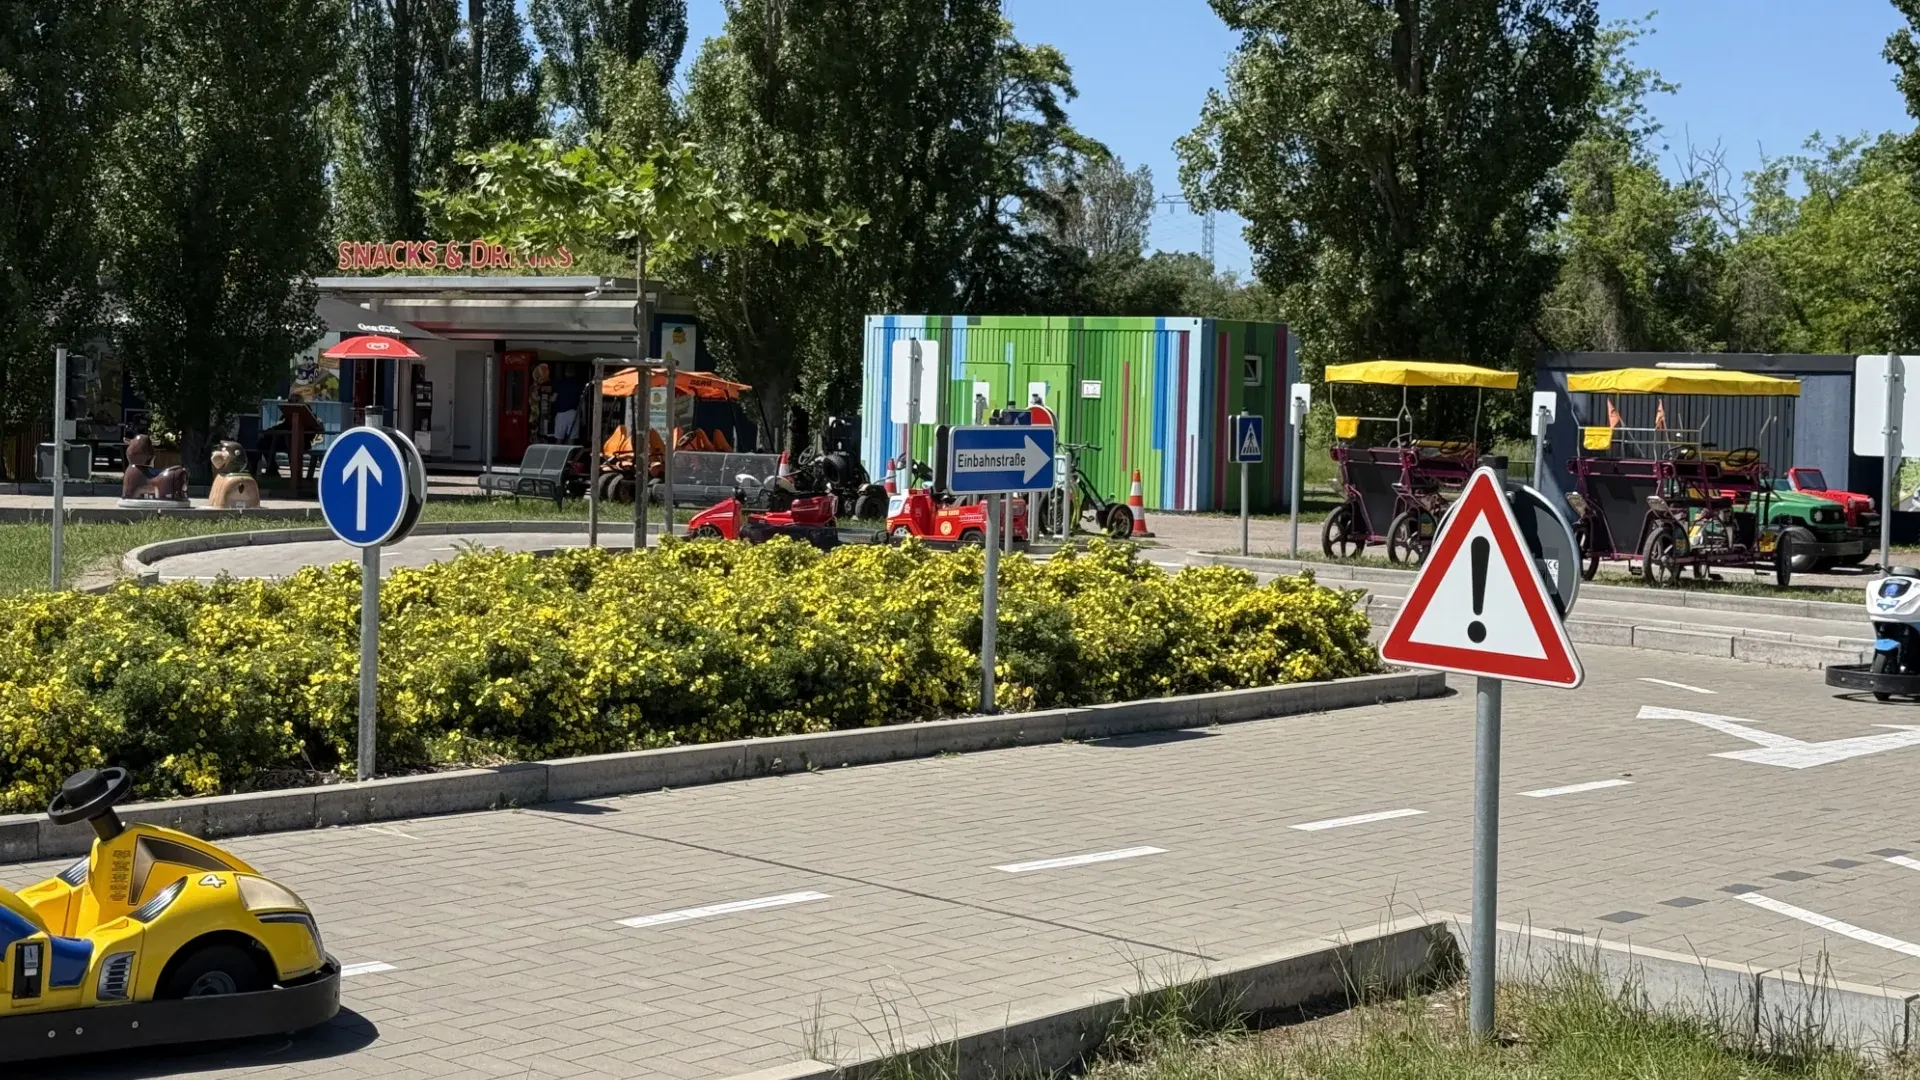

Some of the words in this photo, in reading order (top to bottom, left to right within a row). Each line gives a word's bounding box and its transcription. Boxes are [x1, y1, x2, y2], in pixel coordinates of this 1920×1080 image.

[338, 241, 437, 269] SNACKS
[444, 241, 463, 269] &
[957, 453, 1026, 468] Einbahnstraße
[198, 874, 226, 888] 4
